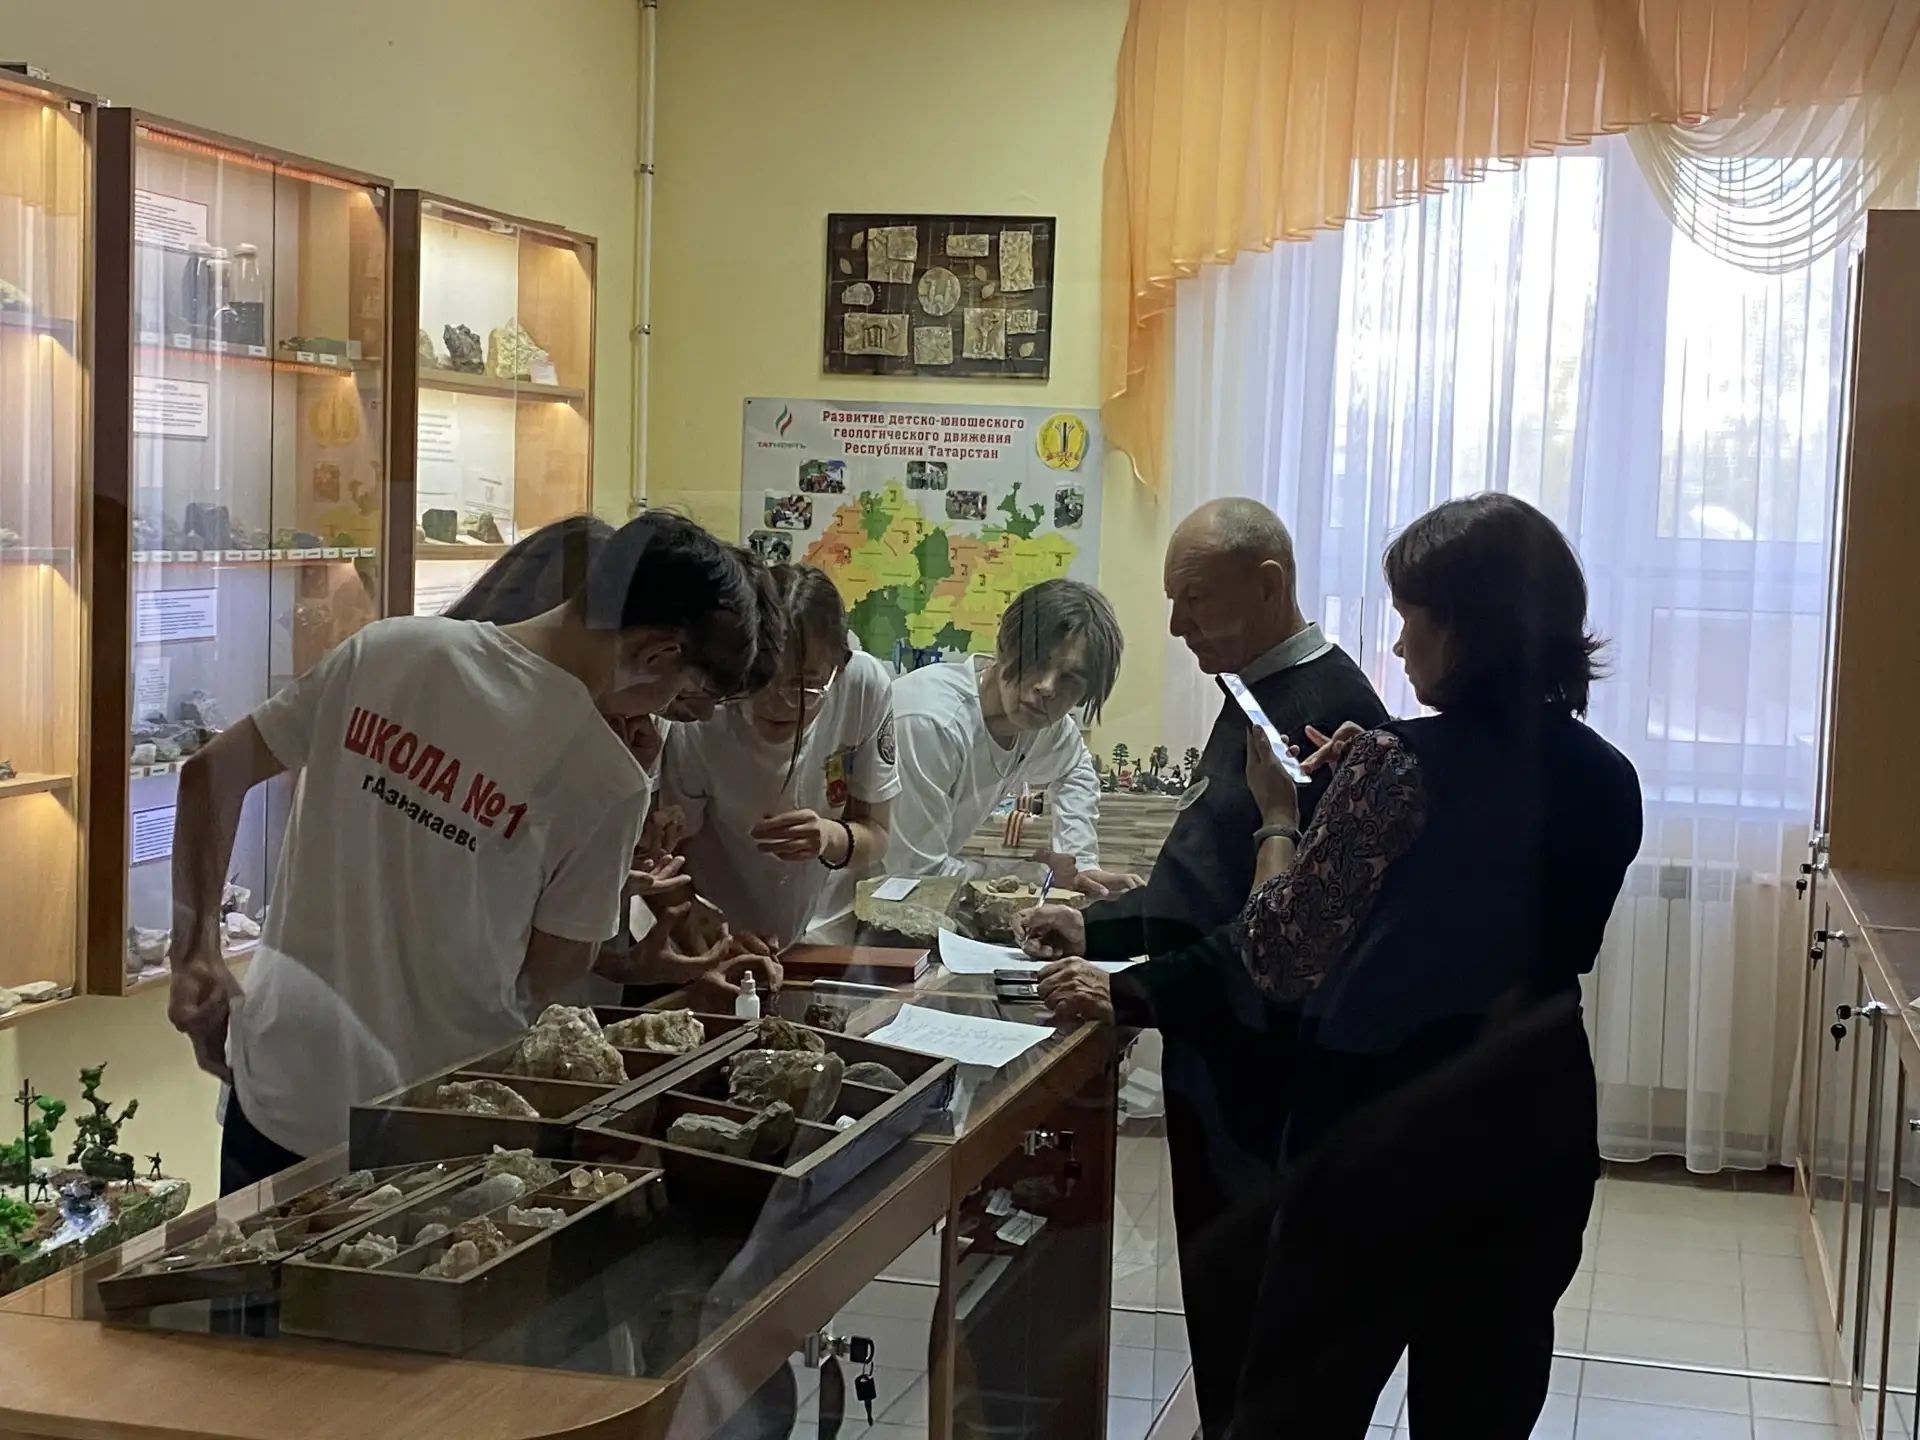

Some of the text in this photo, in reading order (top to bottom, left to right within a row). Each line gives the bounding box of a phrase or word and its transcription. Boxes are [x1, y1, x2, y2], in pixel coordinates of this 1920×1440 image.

[822, 410, 1025, 430] Развитие детско-юношеского
[833, 427, 1012, 444] геологического движения
[844, 442, 999, 460] Республики Татарстан
[344, 706, 529, 839] ШКОЛА №1
